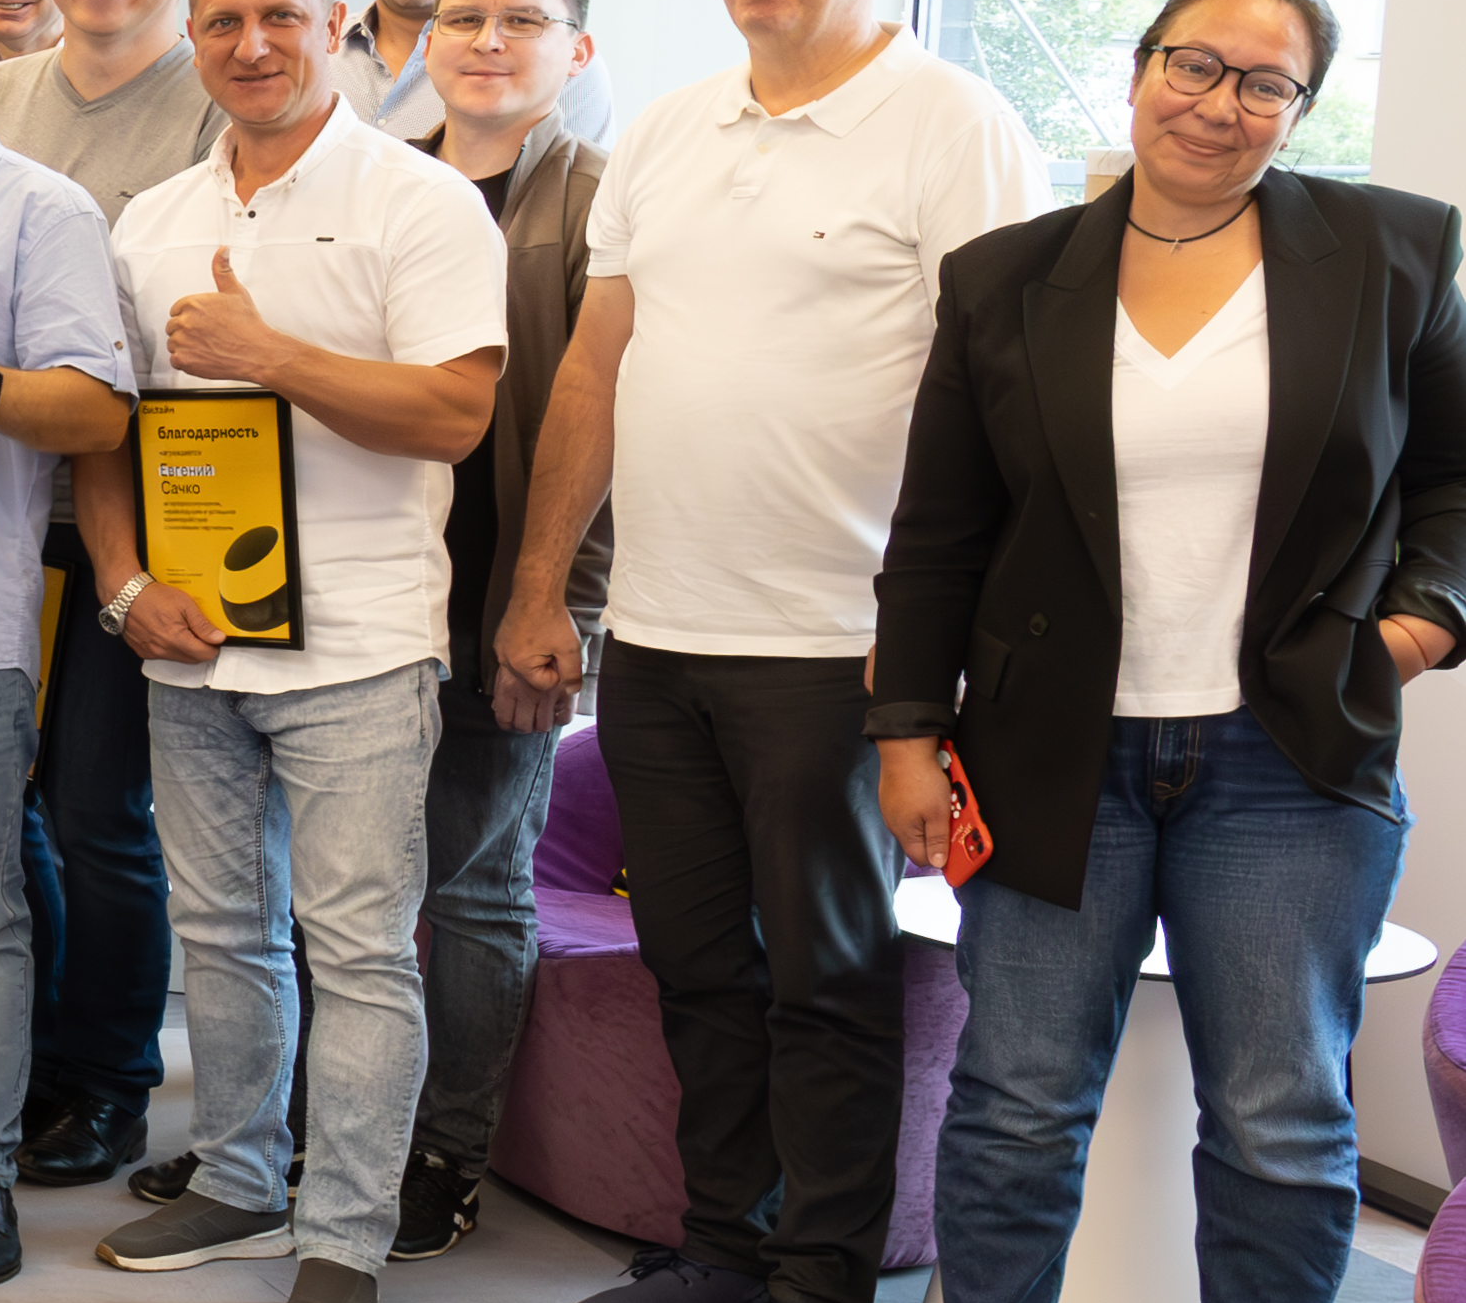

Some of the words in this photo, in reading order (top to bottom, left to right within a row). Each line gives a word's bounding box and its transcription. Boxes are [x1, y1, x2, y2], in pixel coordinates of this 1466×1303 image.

[157, 426, 259, 442] благодарность
[160, 463, 213, 477] Евгений
[161, 480, 201, 495] Сачко
